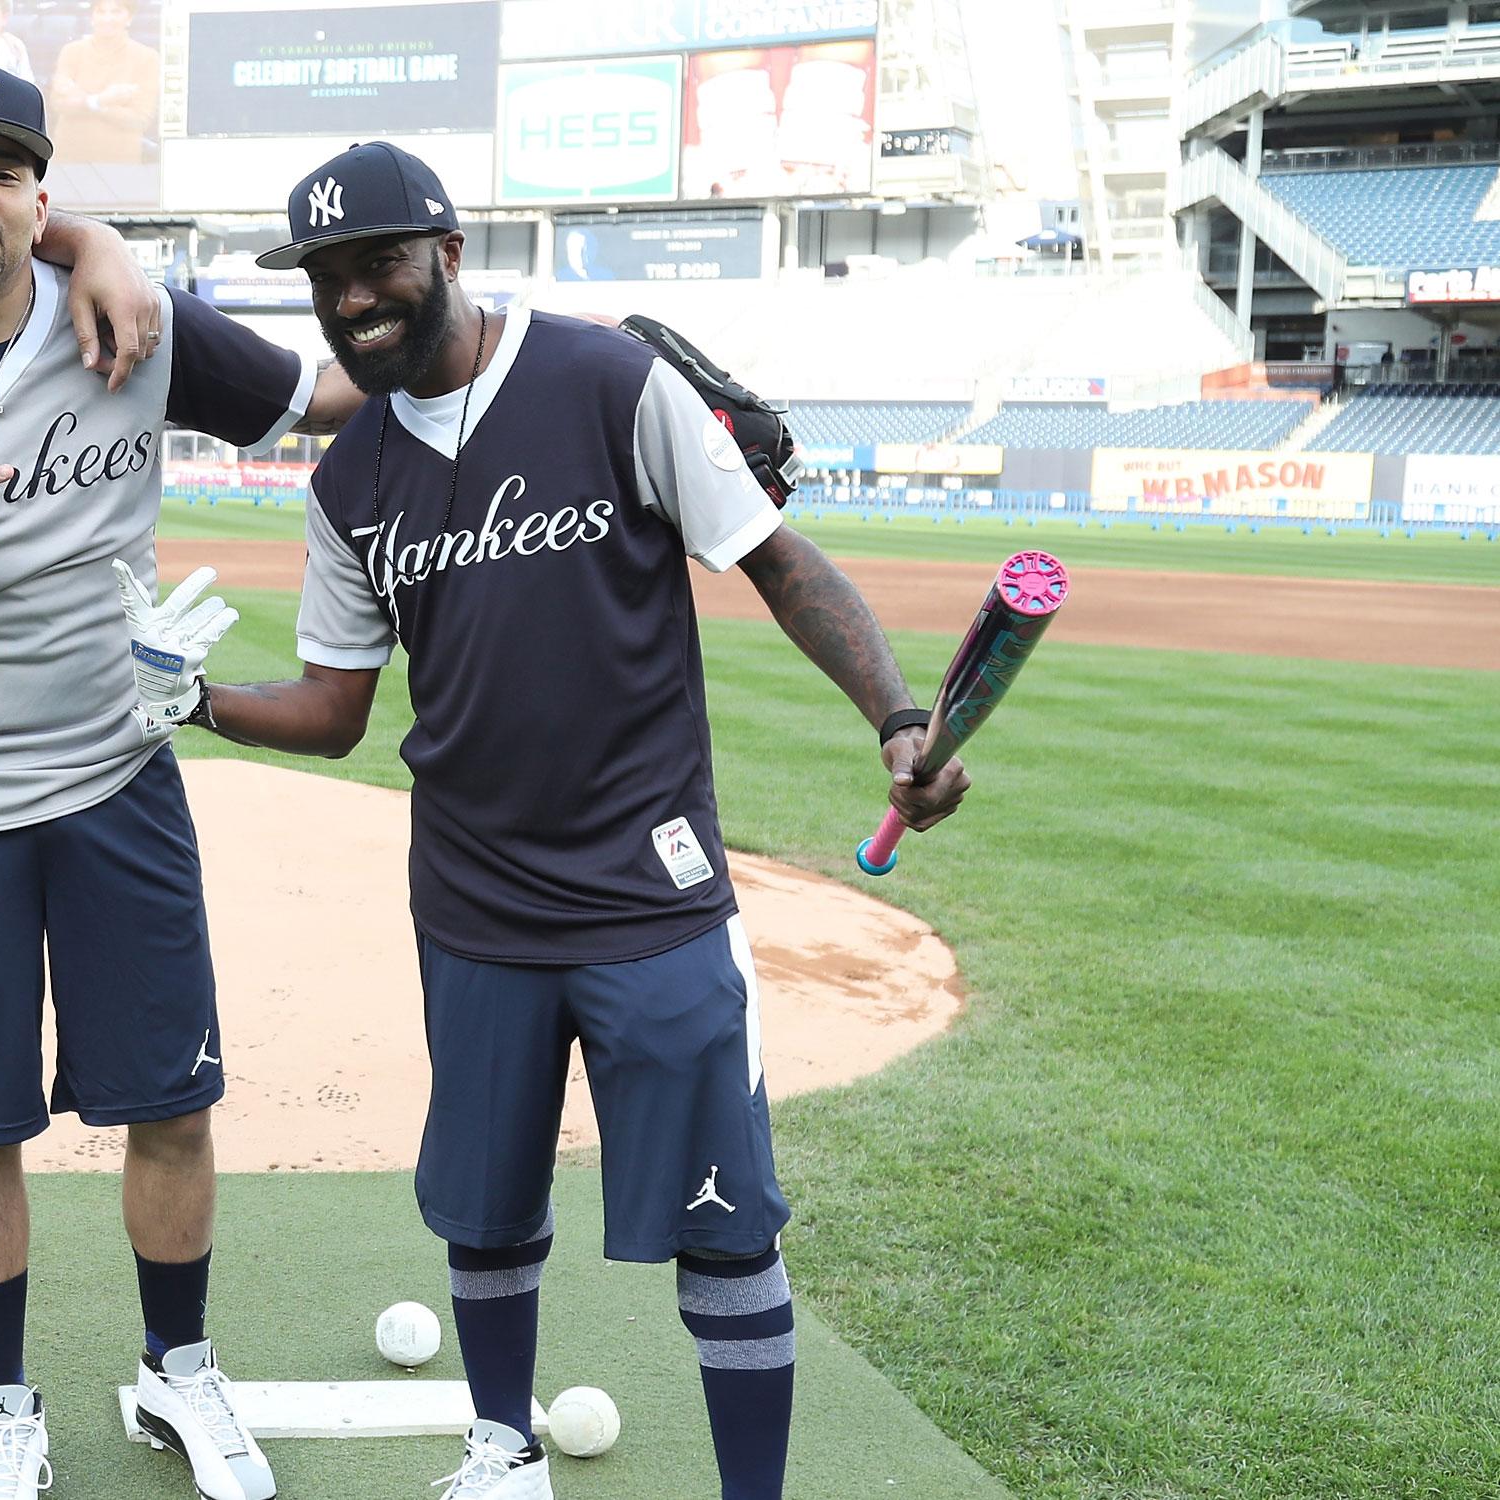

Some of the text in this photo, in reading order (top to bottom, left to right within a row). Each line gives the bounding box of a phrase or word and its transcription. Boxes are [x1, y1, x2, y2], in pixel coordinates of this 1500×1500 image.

[233, 53, 458, 87] CELEBRITY SOFTBALL GAME
[518, 111, 659, 151] HESS
[308, 176, 346, 228] NY
[1202, 460, 1326, 498] MASON
[351, 474, 615, 640] Yankees
[164, 705, 181, 718] 42
